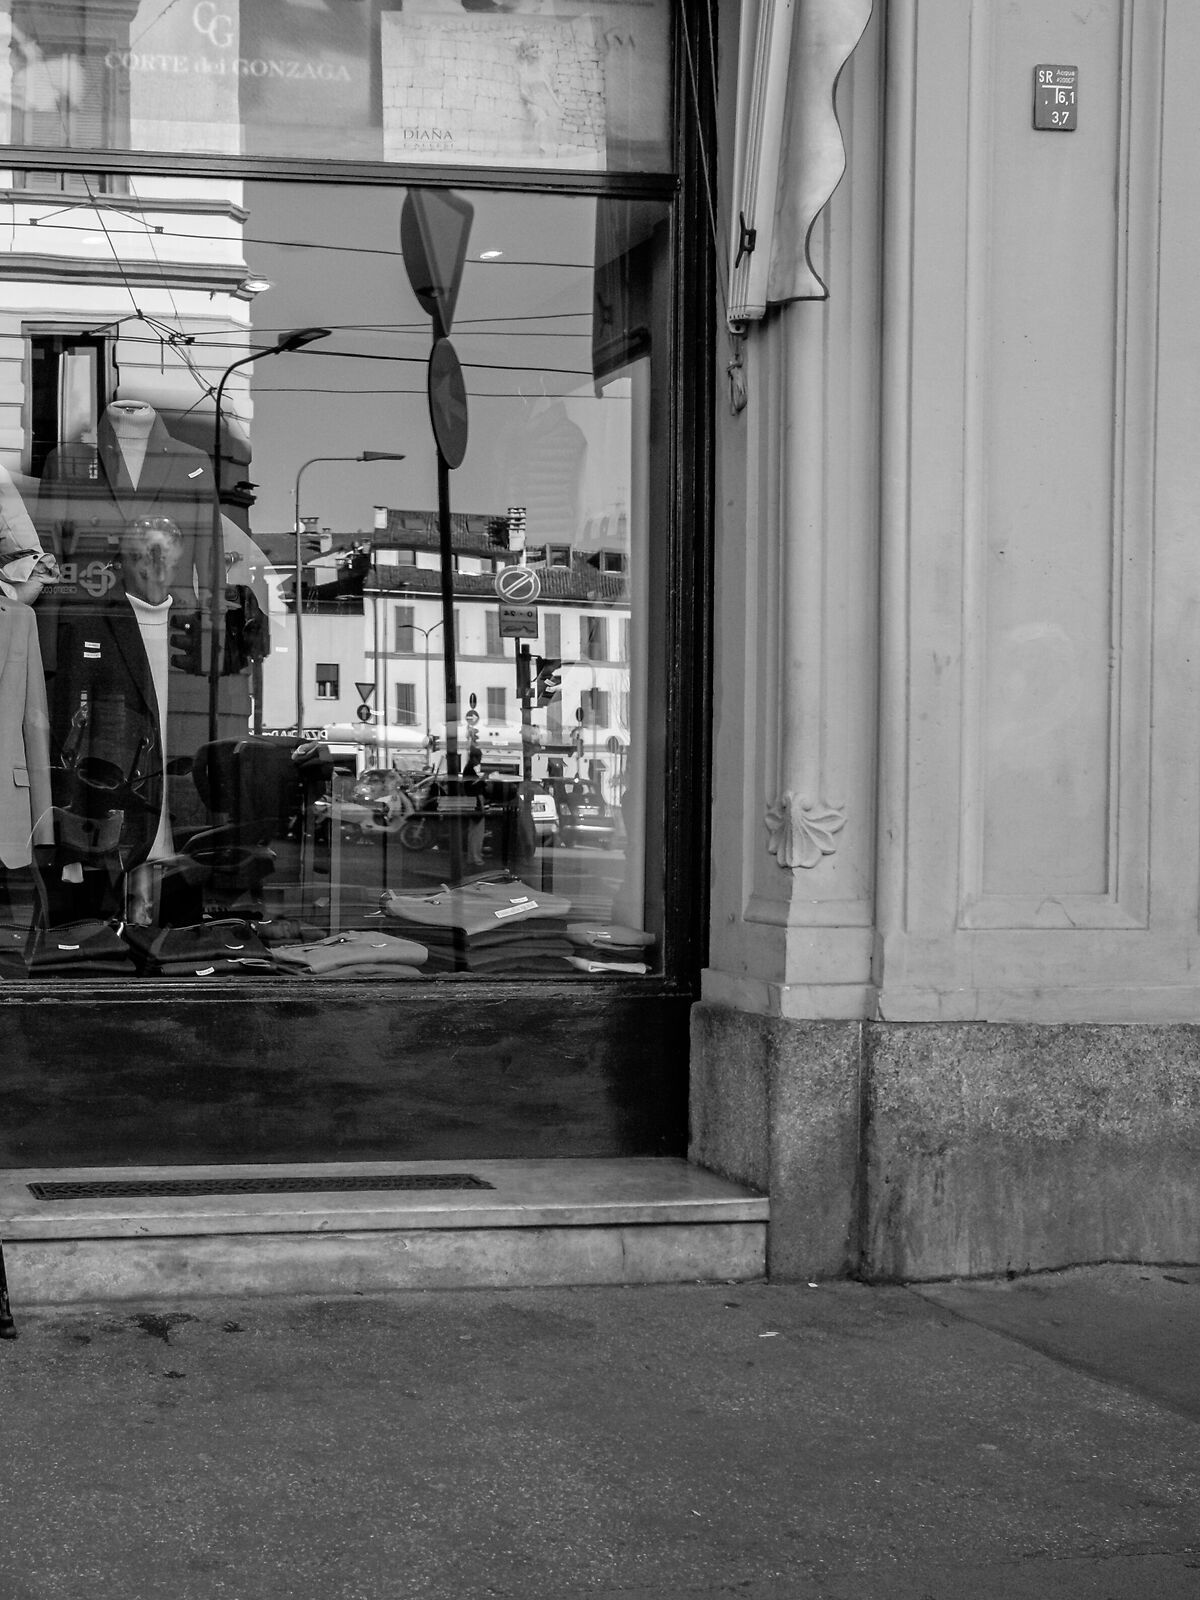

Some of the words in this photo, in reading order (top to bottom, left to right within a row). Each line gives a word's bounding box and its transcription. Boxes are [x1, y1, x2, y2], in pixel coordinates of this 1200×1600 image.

[104, 52, 188, 73] CORTE
[232, 58, 351, 81] GONZAGA
[1038, 70, 1053, 83] SR
[1051, 111, 1070, 126] 3,7
